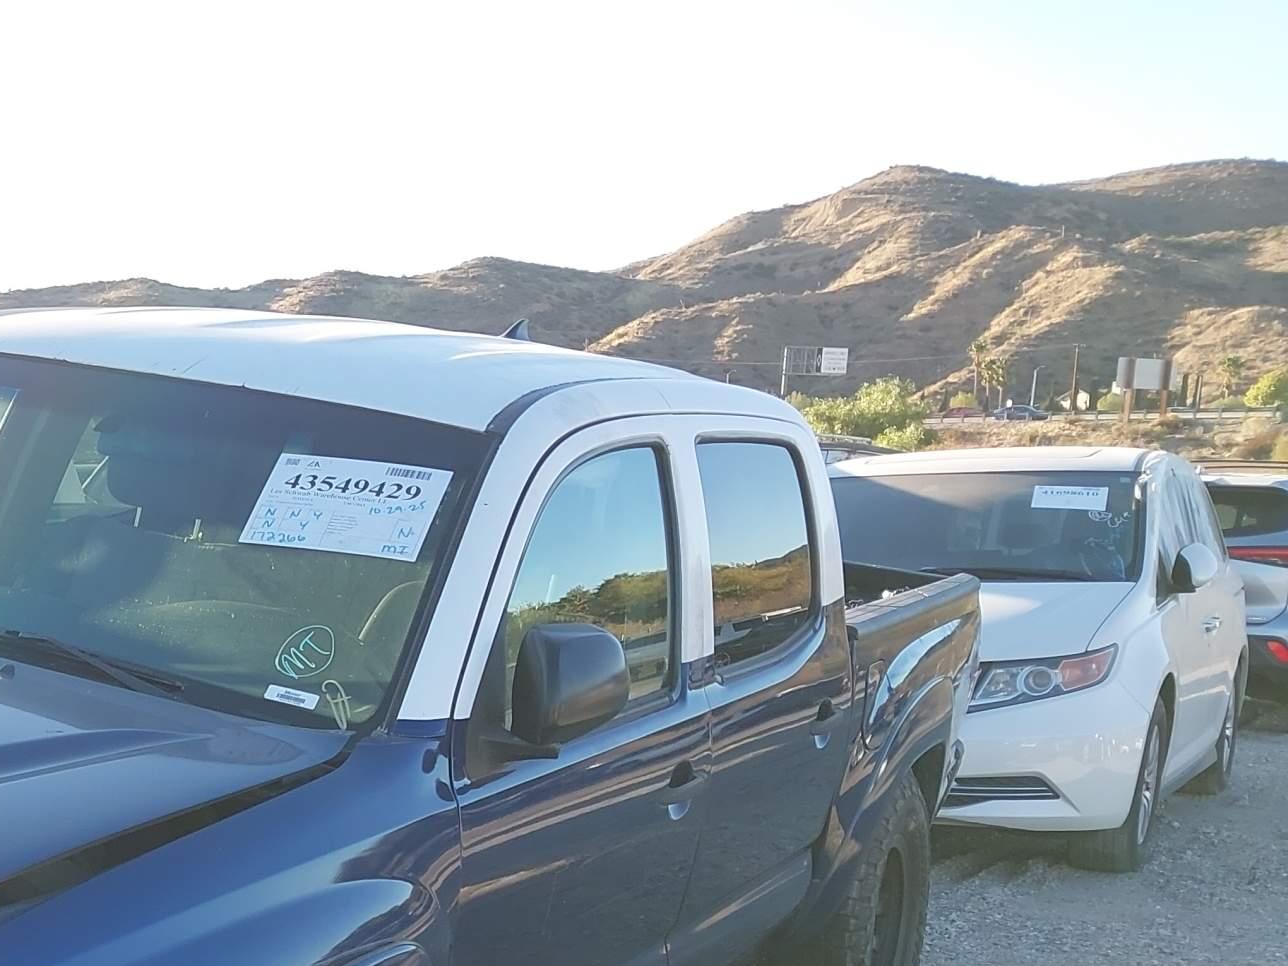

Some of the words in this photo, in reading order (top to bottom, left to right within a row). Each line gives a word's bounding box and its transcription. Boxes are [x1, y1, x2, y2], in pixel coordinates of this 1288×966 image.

[284, 473, 422, 501] 43549429
[264, 507, 278, 519] N
[288, 508, 302, 520] N
